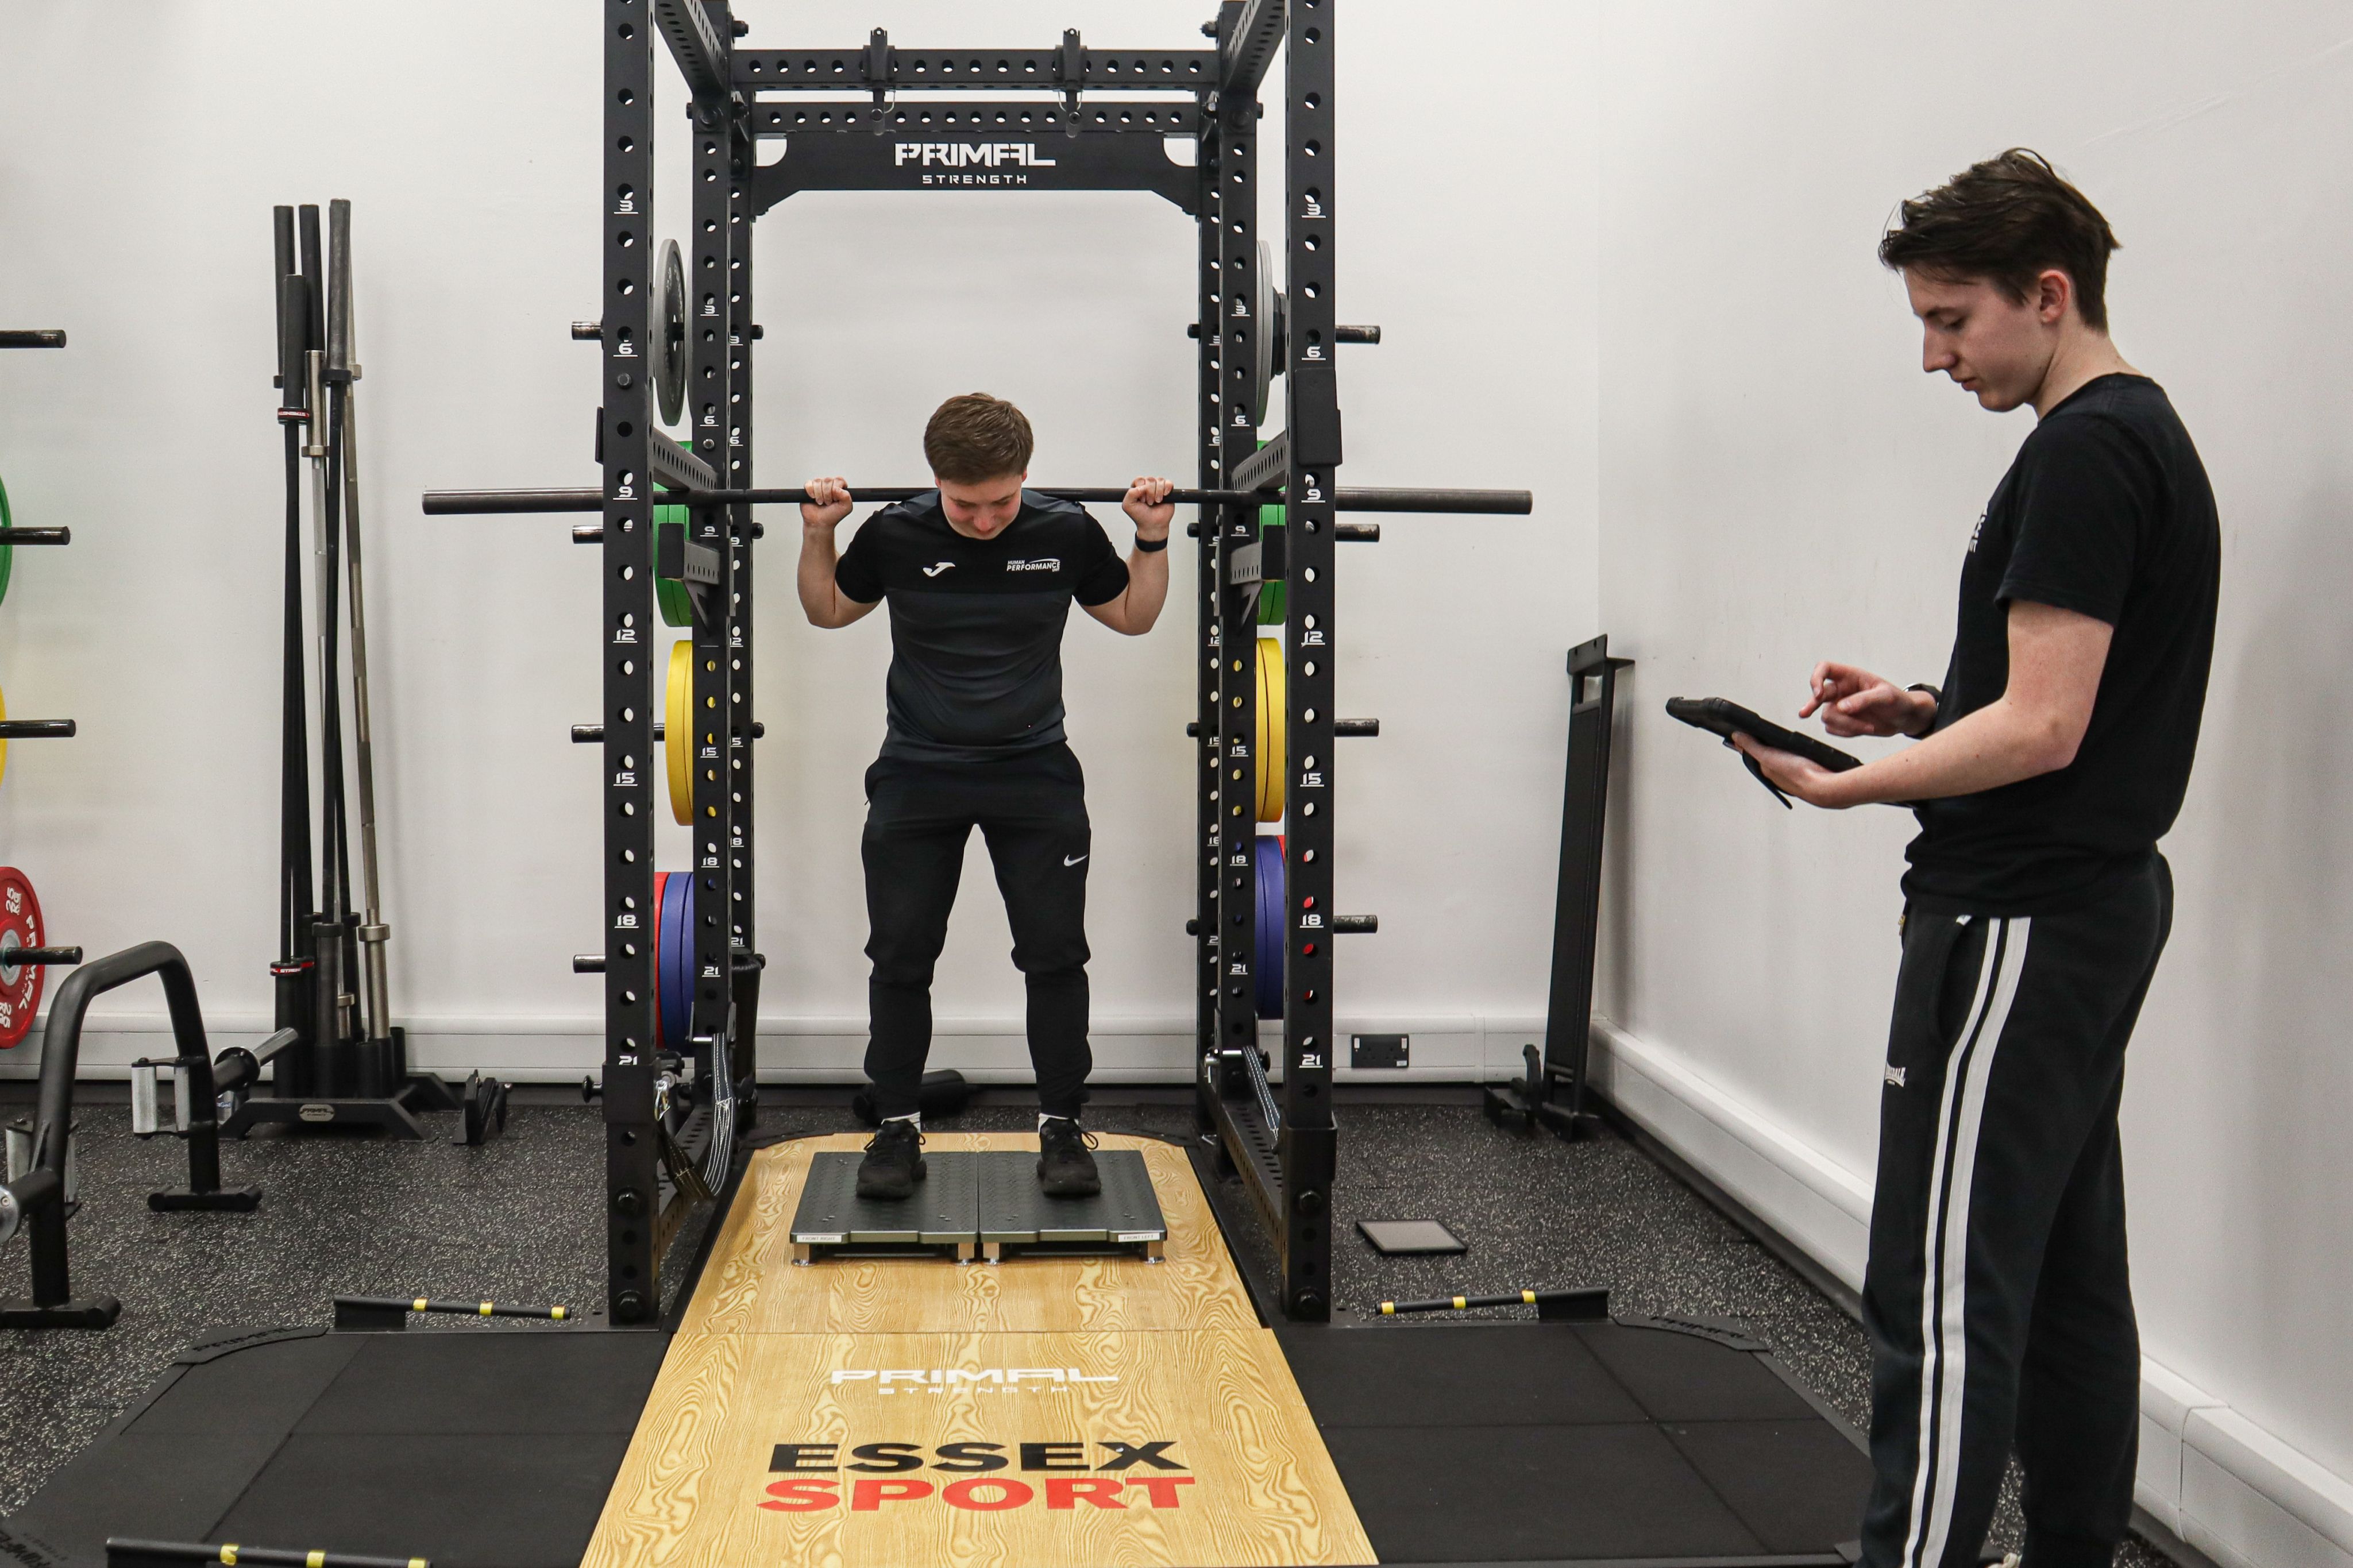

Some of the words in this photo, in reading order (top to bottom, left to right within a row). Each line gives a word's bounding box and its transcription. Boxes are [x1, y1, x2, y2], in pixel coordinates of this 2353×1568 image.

[895, 143, 1056, 167] PRIMAL
[922, 175, 1027, 184] STRENGTH
[1006, 561, 1060, 571] PERFORMANCE
[18, 914, 37, 1010] PRMAL
[831, 1368, 1119, 1384] PRIMAL
[768, 1441, 1190, 1473] ESSEX
[756, 1477, 1195, 1511] SPORT
